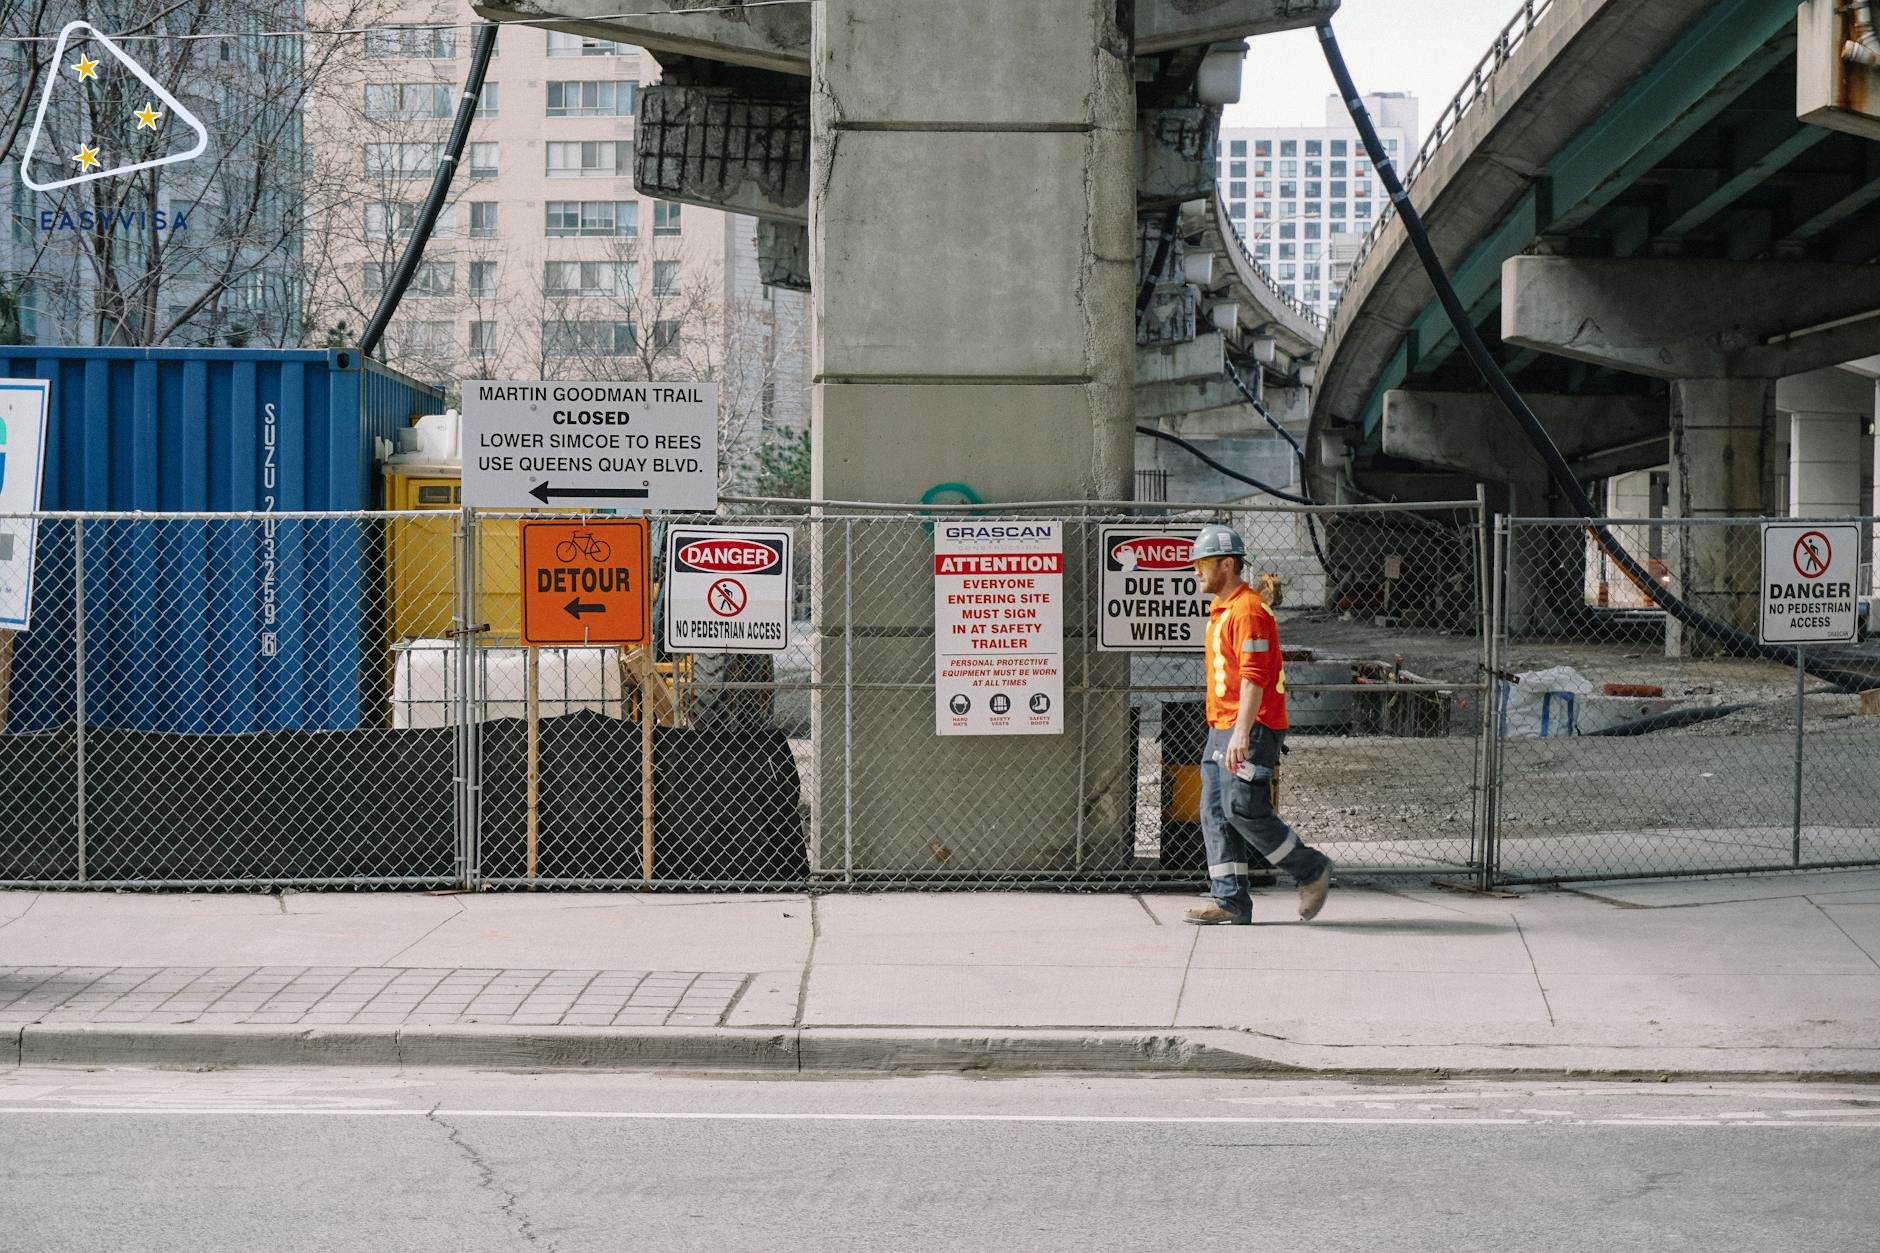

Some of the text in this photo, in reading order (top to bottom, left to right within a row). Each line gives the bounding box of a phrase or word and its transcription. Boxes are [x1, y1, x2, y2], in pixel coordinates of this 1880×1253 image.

[479, 386, 703, 403] MARTIN GOODMAN TRAIL
[552, 410, 630, 425] CLOSED
[264, 403, 276, 489] SUZU
[480, 433, 701, 450] LOWER SIMCOE TO REES
[478, 456, 703, 473] USE QUEENS QUAY BLVD.
[946, 526, 1051, 538] GRASCAN
[687, 547, 769, 565] DANGER
[1120, 545, 1195, 562] ANGE
[941, 556, 1058, 572] ATTENTION
[537, 567, 630, 593] DETOUR
[963, 578, 1035, 589] EVERYONE
[1125, 577, 1197, 596] DUE TO
[948, 593, 1050, 604] ENTERING SITE
[1770, 582, 1851, 599] DANGER
[962, 608, 1036, 619] MUST SIGN
[1107, 599, 1212, 618] OVERHEAD
[1769, 602, 1851, 614] NO PEDESTRIAN
[676, 619, 781, 640] NO PEDESTRIAN ACCESS
[952, 623, 1042, 634] IN AT SAFETY
[1790, 616, 1831, 628] ACCESS
[1130, 622, 1191, 641] WIRES
[264, 633, 275, 655] 6
[971, 639, 1028, 649] TRAILER
[950, 658, 1049, 667] PERSONAL PROTECTIVE
[942, 669, 991, 677] EQUIPMENT
[1032, 668, 1057, 676] WORN
